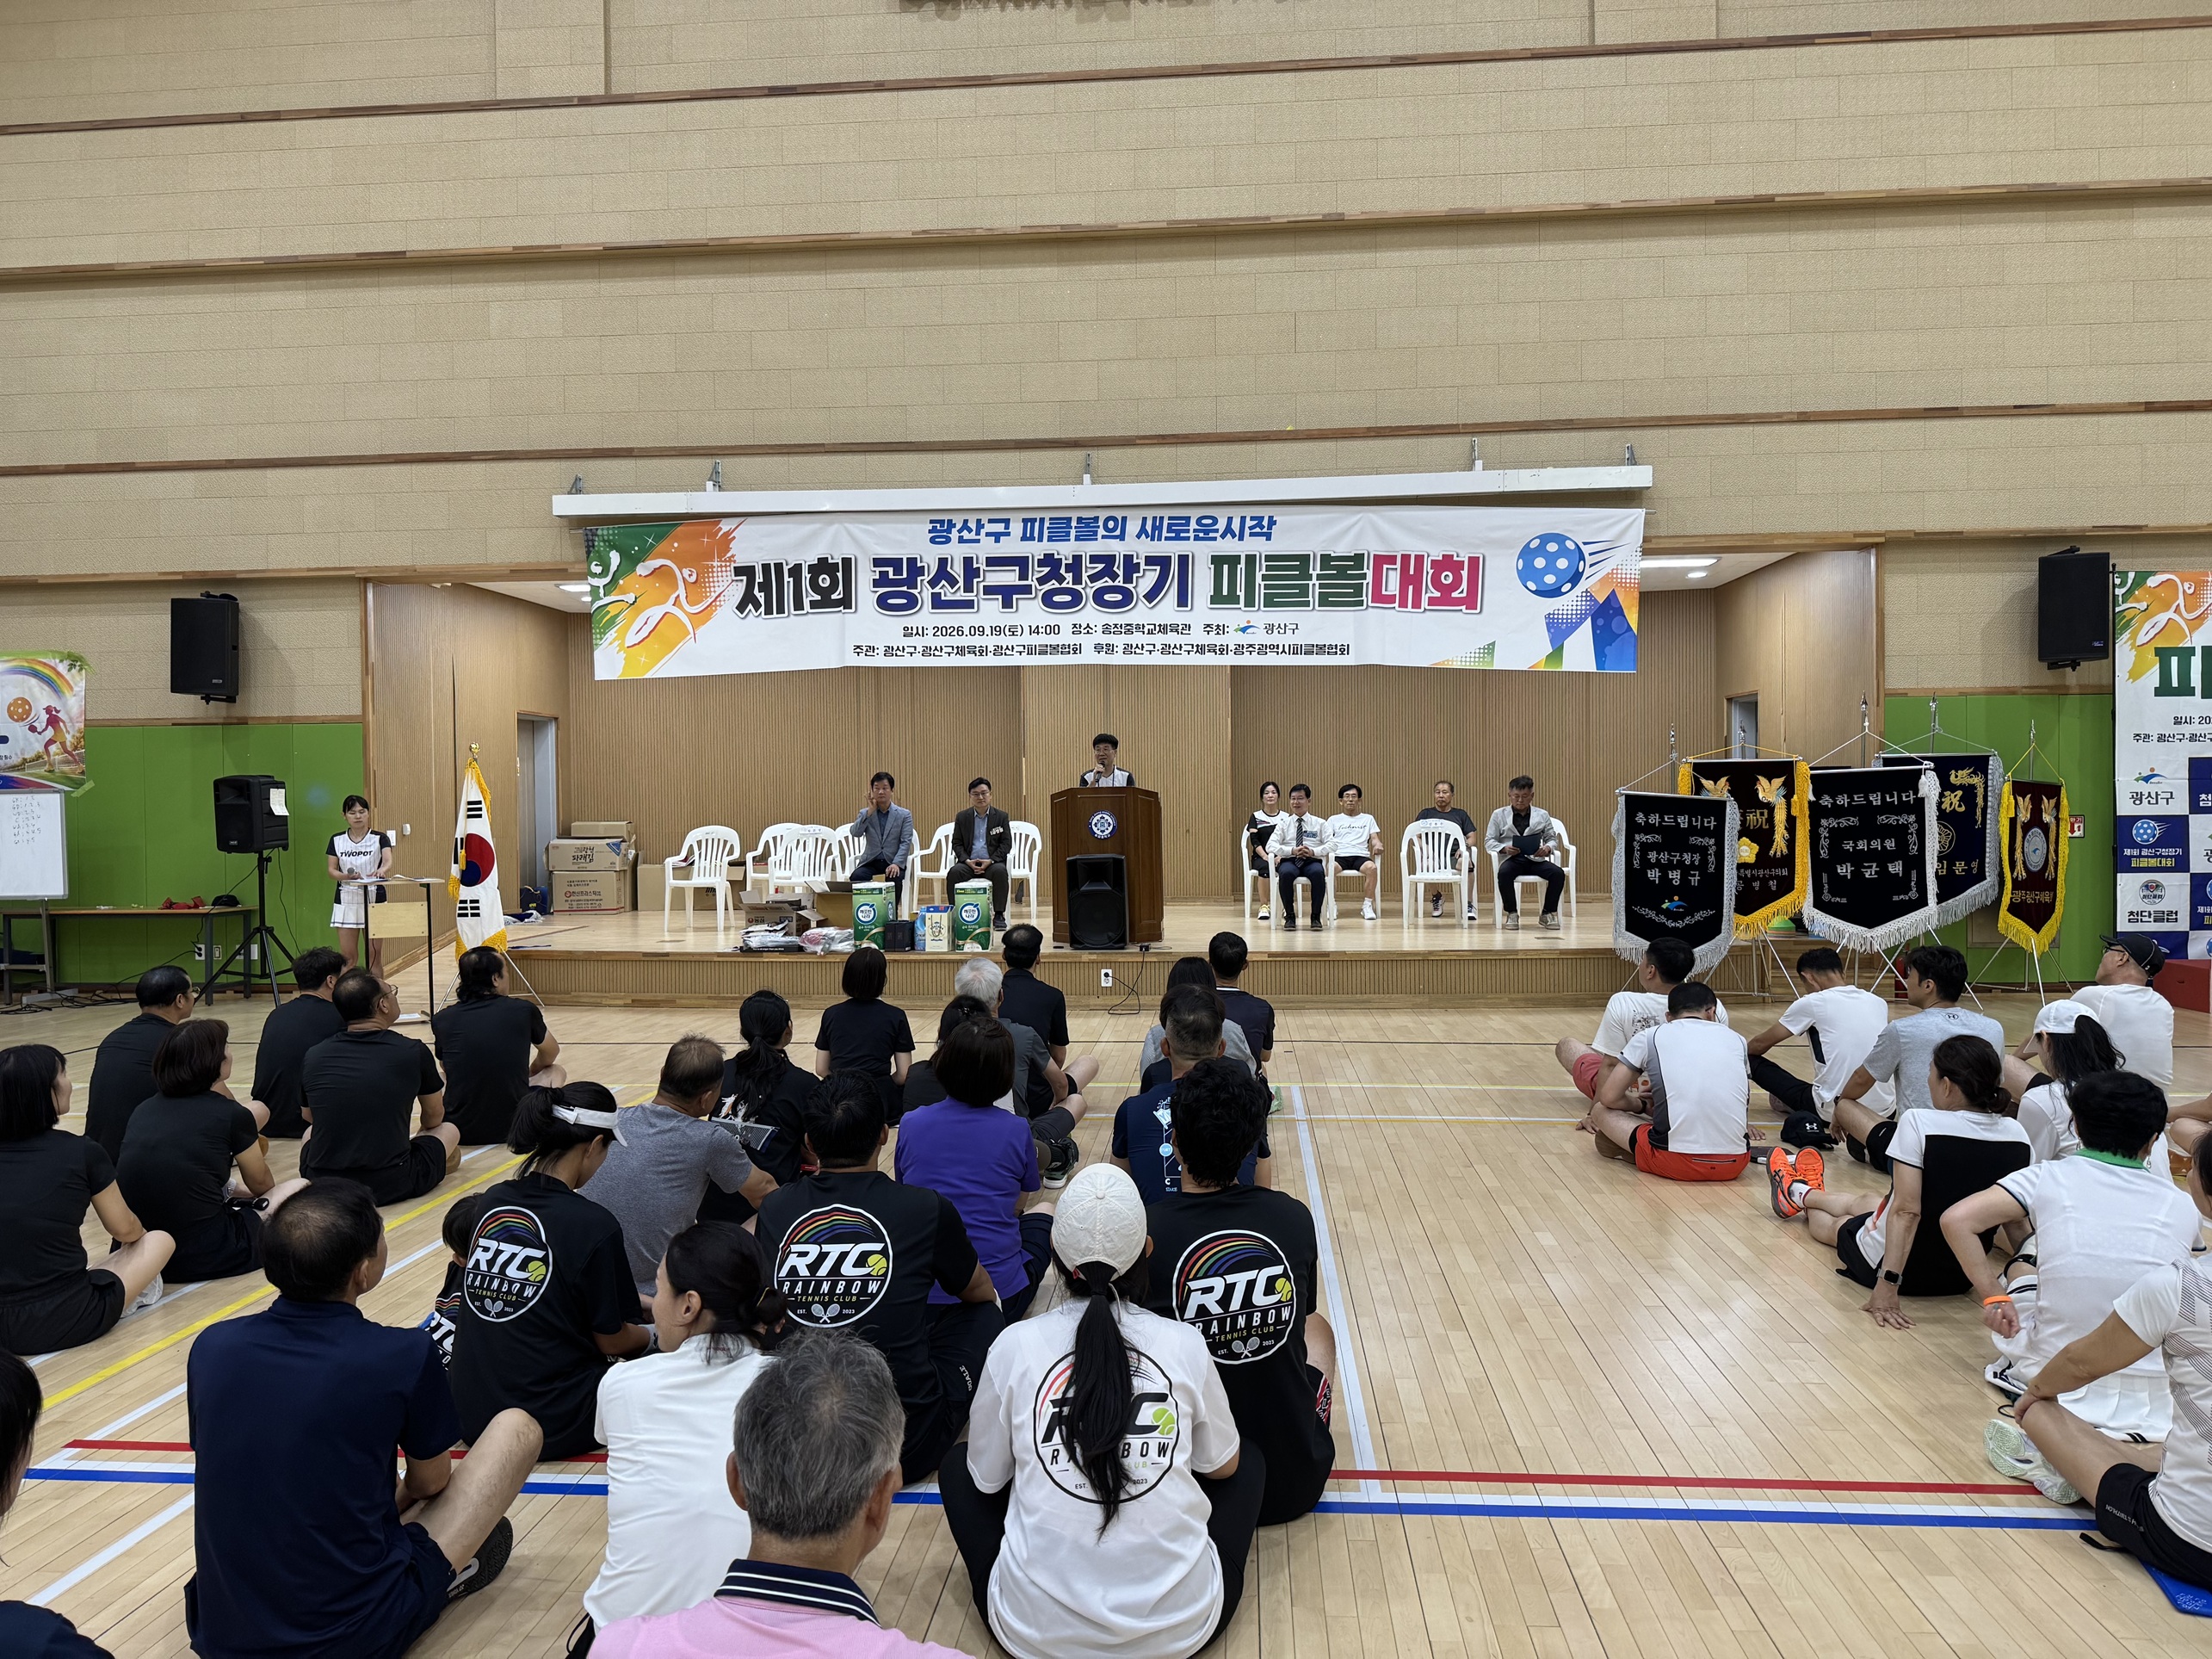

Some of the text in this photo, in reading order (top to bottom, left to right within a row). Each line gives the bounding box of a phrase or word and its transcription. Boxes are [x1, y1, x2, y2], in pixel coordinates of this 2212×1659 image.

[927, 515, 1276, 544] 광산구 피클볼의 새로운시작
[733, 555, 855, 616] 제1회
[870, 552, 1190, 615] 광산구청장기
[903, 622, 1300, 638] 일시: 2026.09.19(토) 14:00 장소: 송정중학교체육관 주최: 광산구
[853, 645, 879, 657] 주관:
[1094, 642, 1118, 655] 후원:
[2173, 715, 2212, 726] 일시: 20
[2133, 734, 2153, 742] 주관:
[1819, 790, 1917, 808] 축하드립니다
[1941, 789, 1966, 813] 祝
[2129, 791, 2175, 806] 광산구
[1634, 812, 1717, 830] 축하드립니다
[1842, 838, 1896, 852] 국회의원
[340, 849, 374, 858] TWOPOT
[1647, 851, 1701, 865] 광산구청장
[2130, 857, 2175, 867] 피클볼대회
[2127, 910, 2178, 924] 첨단클럽
[466, 1238, 547, 1279] RTC
[777, 1243, 886, 1277] RTC
[466, 1274, 536, 1298] RAINBOW
[783, 1280, 881, 1295] RAINBOW
[1183, 1265, 1285, 1320] RTC
[474, 1288, 516, 1301] TENNIS CLUB
[1194, 1305, 1292, 1336] RAINBOW
[1215, 1326, 1275, 1342] TENNIS CLUB
